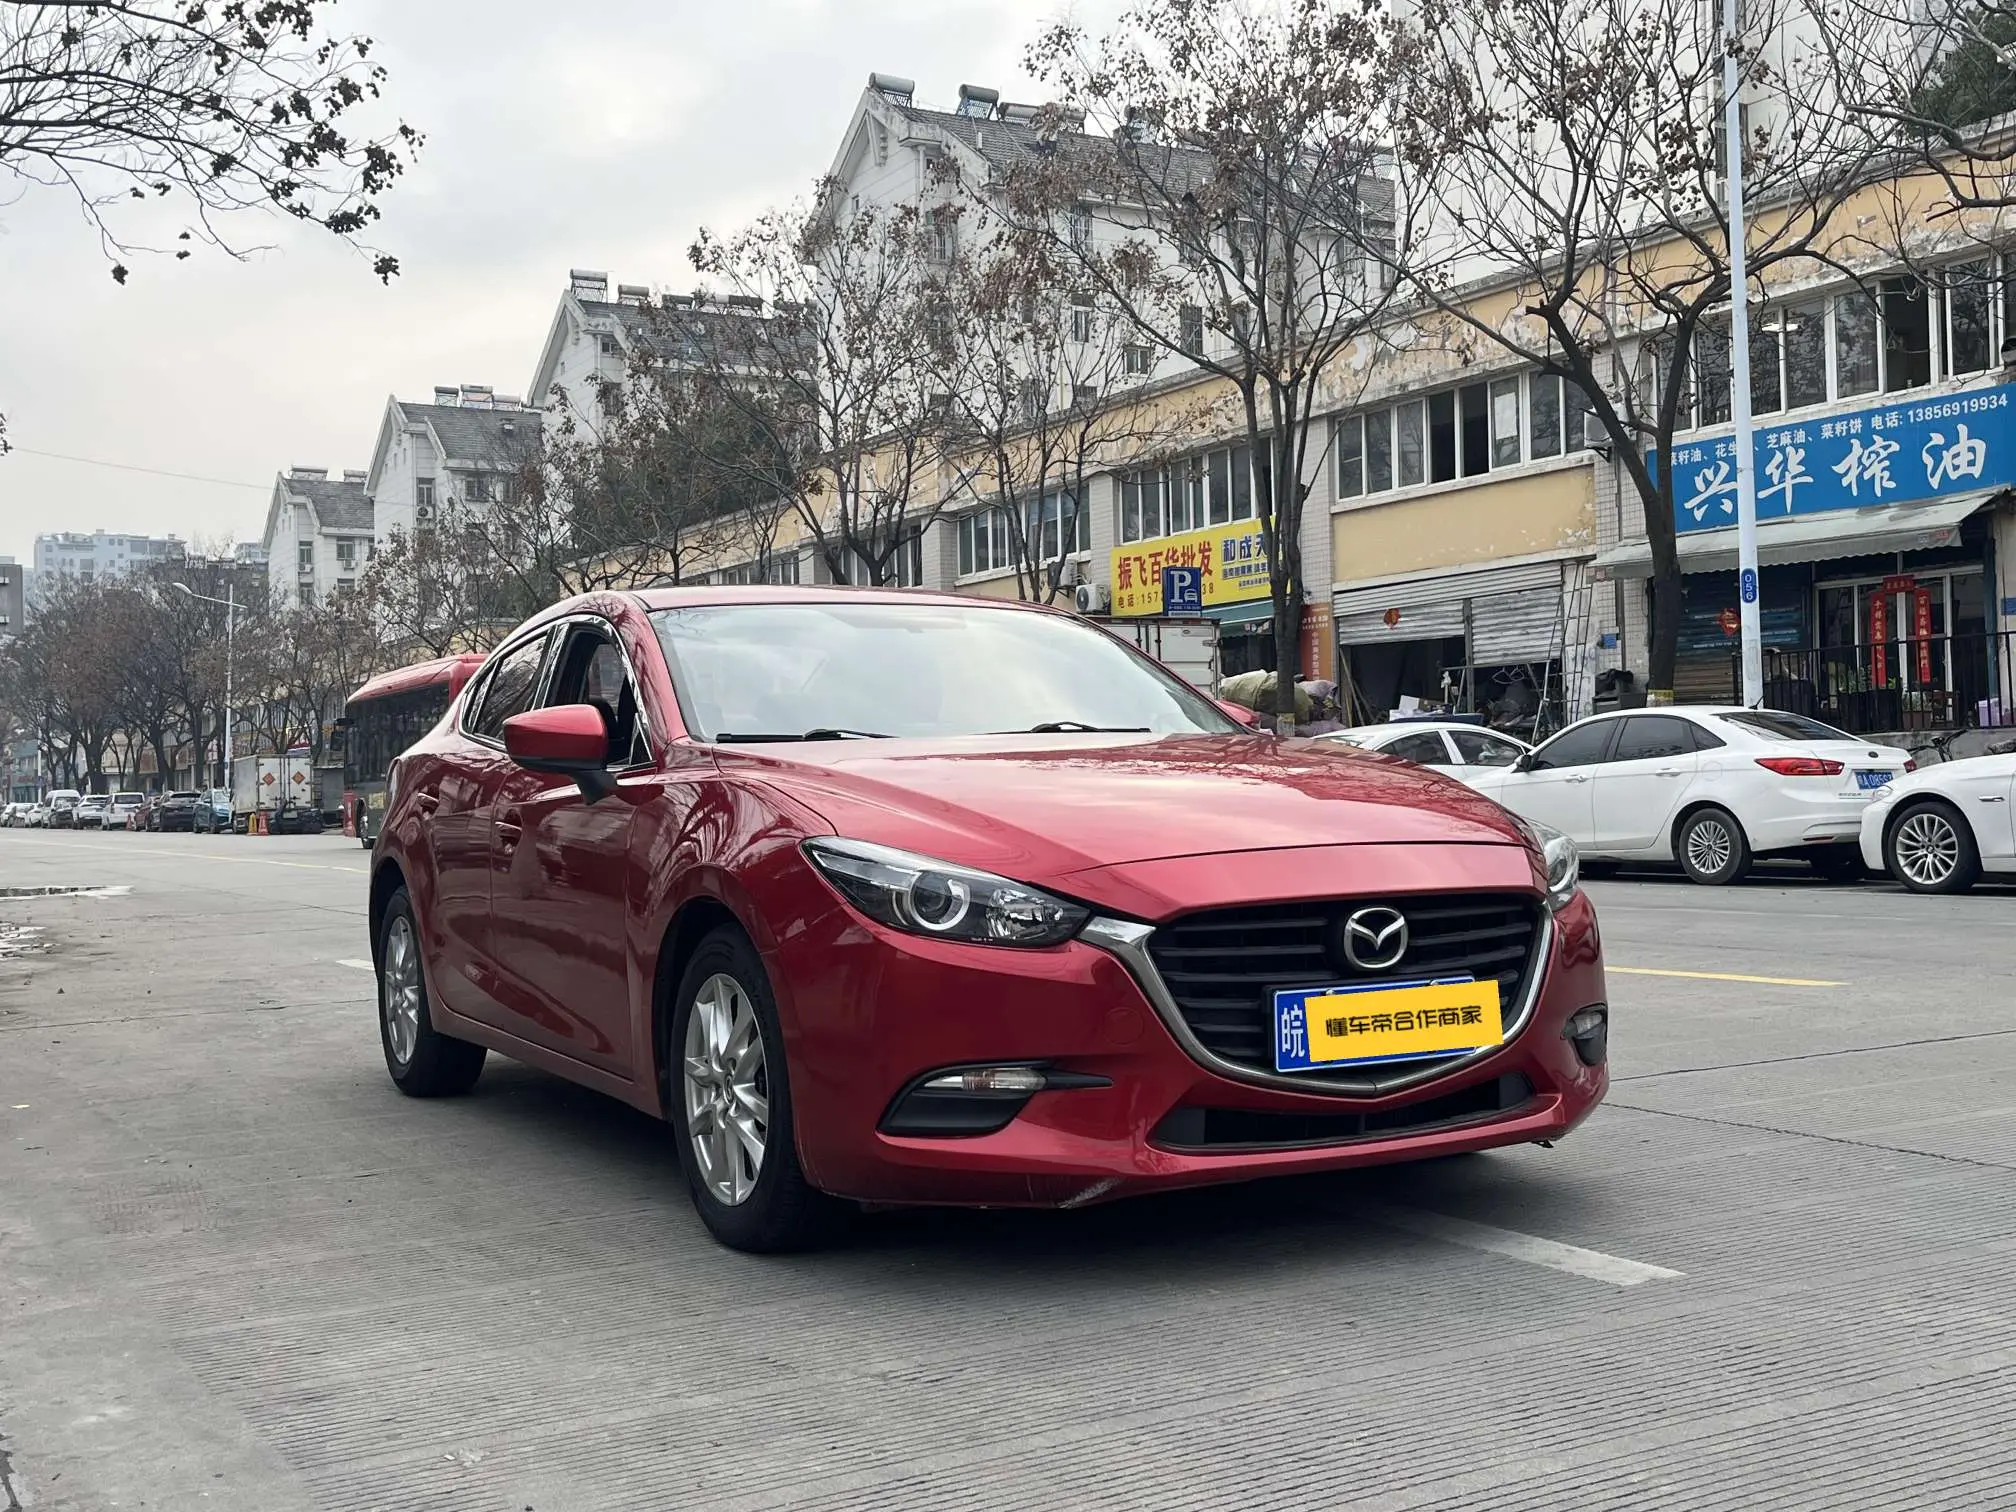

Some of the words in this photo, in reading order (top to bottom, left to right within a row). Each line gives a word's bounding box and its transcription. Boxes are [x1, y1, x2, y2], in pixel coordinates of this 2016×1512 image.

[1684, 424, 1986, 521] 兴华榨油
[1170, 571, 1192, 603] P
[1744, 574, 1753, 600] 056
[1281, 1004, 1305, 1058] 皖
